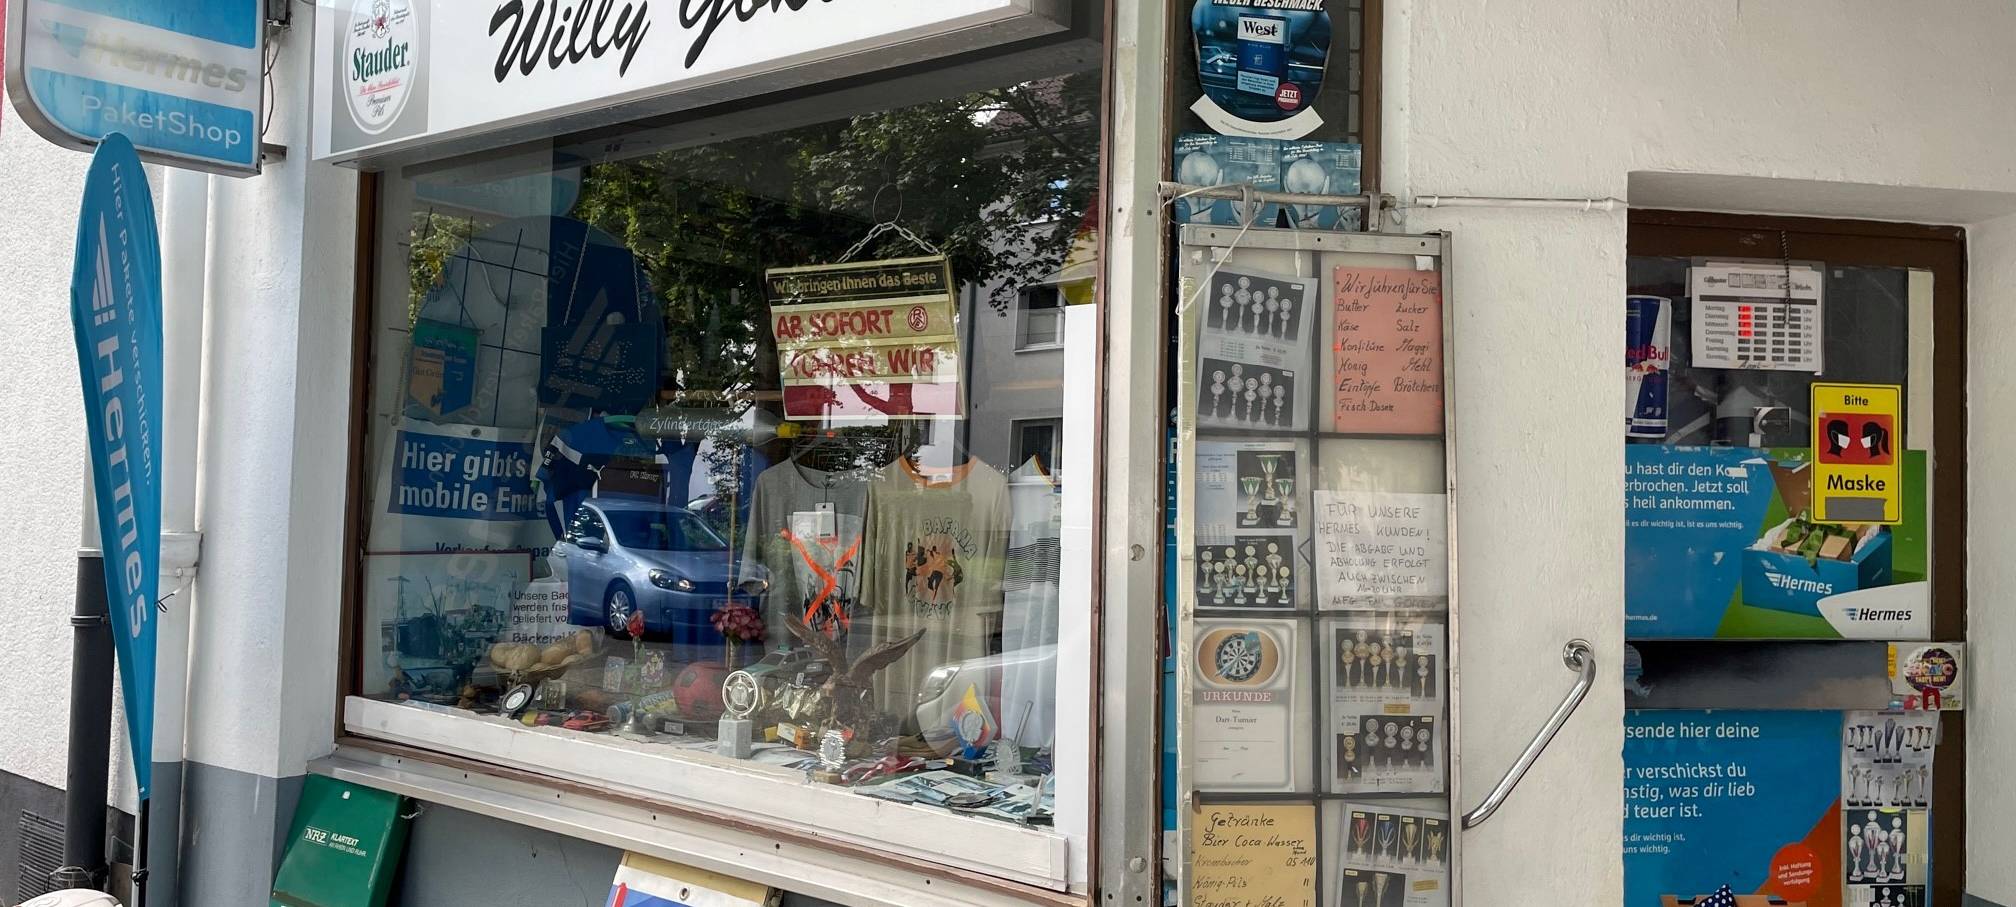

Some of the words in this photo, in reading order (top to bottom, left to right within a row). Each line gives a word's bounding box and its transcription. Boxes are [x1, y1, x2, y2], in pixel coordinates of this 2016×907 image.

[1243, 21, 1278, 36] West
[488, 0, 651, 83] Willy
[91, 27, 247, 93] Hermes
[353, 36, 408, 82] Stauder
[1280, 89, 1297, 98] JETZT
[81, 95, 241, 149] PaketShop
[842, 275, 877, 289] Ihnen
[880, 273, 900, 287] das
[1336, 299, 1370, 312] Butter
[111, 162, 124, 220] Hier
[120, 232, 135, 327] Pakete
[129, 332, 151, 486] verschicken.
[1396, 319, 1420, 332] Salz
[1844, 395, 1869, 406] Bitte
[400, 440, 456, 474] Hier
[463, 451, 527, 483] gibt's
[1636, 461, 1665, 475] hast
[1668, 462, 1685, 475] dir
[1688, 463, 1712, 476] den
[97, 335, 148, 639] Hermes
[1624, 479, 1689, 492] erbrochen.
[1692, 480, 1723, 493] Jetzt
[1726, 480, 1749, 494] soll
[1827, 474, 1886, 491] Maske
[399, 480, 488, 513] mobile
[1633, 496, 1656, 509] heil
[1660, 497, 1736, 510] ankommen.
[1368, 506, 1421, 518] UNSERE
[1326, 541, 1346, 552] DIE
[1400, 546, 1424, 556] UND
[1384, 558, 1430, 568] ERFOLGT
[1781, 574, 1833, 595] Hermes
[514, 591, 548, 601] Unsere
[513, 602, 548, 612] werden
[512, 613, 552, 625] geliefert
[1859, 608, 1912, 622] Hermes
[1202, 691, 1272, 702] URKUNDE
[1625, 722, 1675, 738] sende
[1679, 722, 1711, 738] hier
[1715, 722, 1760, 738] deine
[1636, 763, 1723, 779] verschickst
[1727, 762, 1746, 777] du
[1624, 784, 1664, 801] nstig,
[1668, 786, 1699, 798] was
[1703, 783, 1724, 798] dir
[1727, 782, 1755, 797] lieb
[1634, 805, 1676, 818] teuer
[1679, 803, 1703, 818] ist.
[1205, 812, 1275, 833] Getränke
[330, 833, 359, 846] KLARTEXT
[1202, 832, 1229, 847] Bier
[1630, 832, 1641, 842] dir
[1643, 832, 1672, 844] wichtig
[1640, 844, 1671, 855] wichtig.
